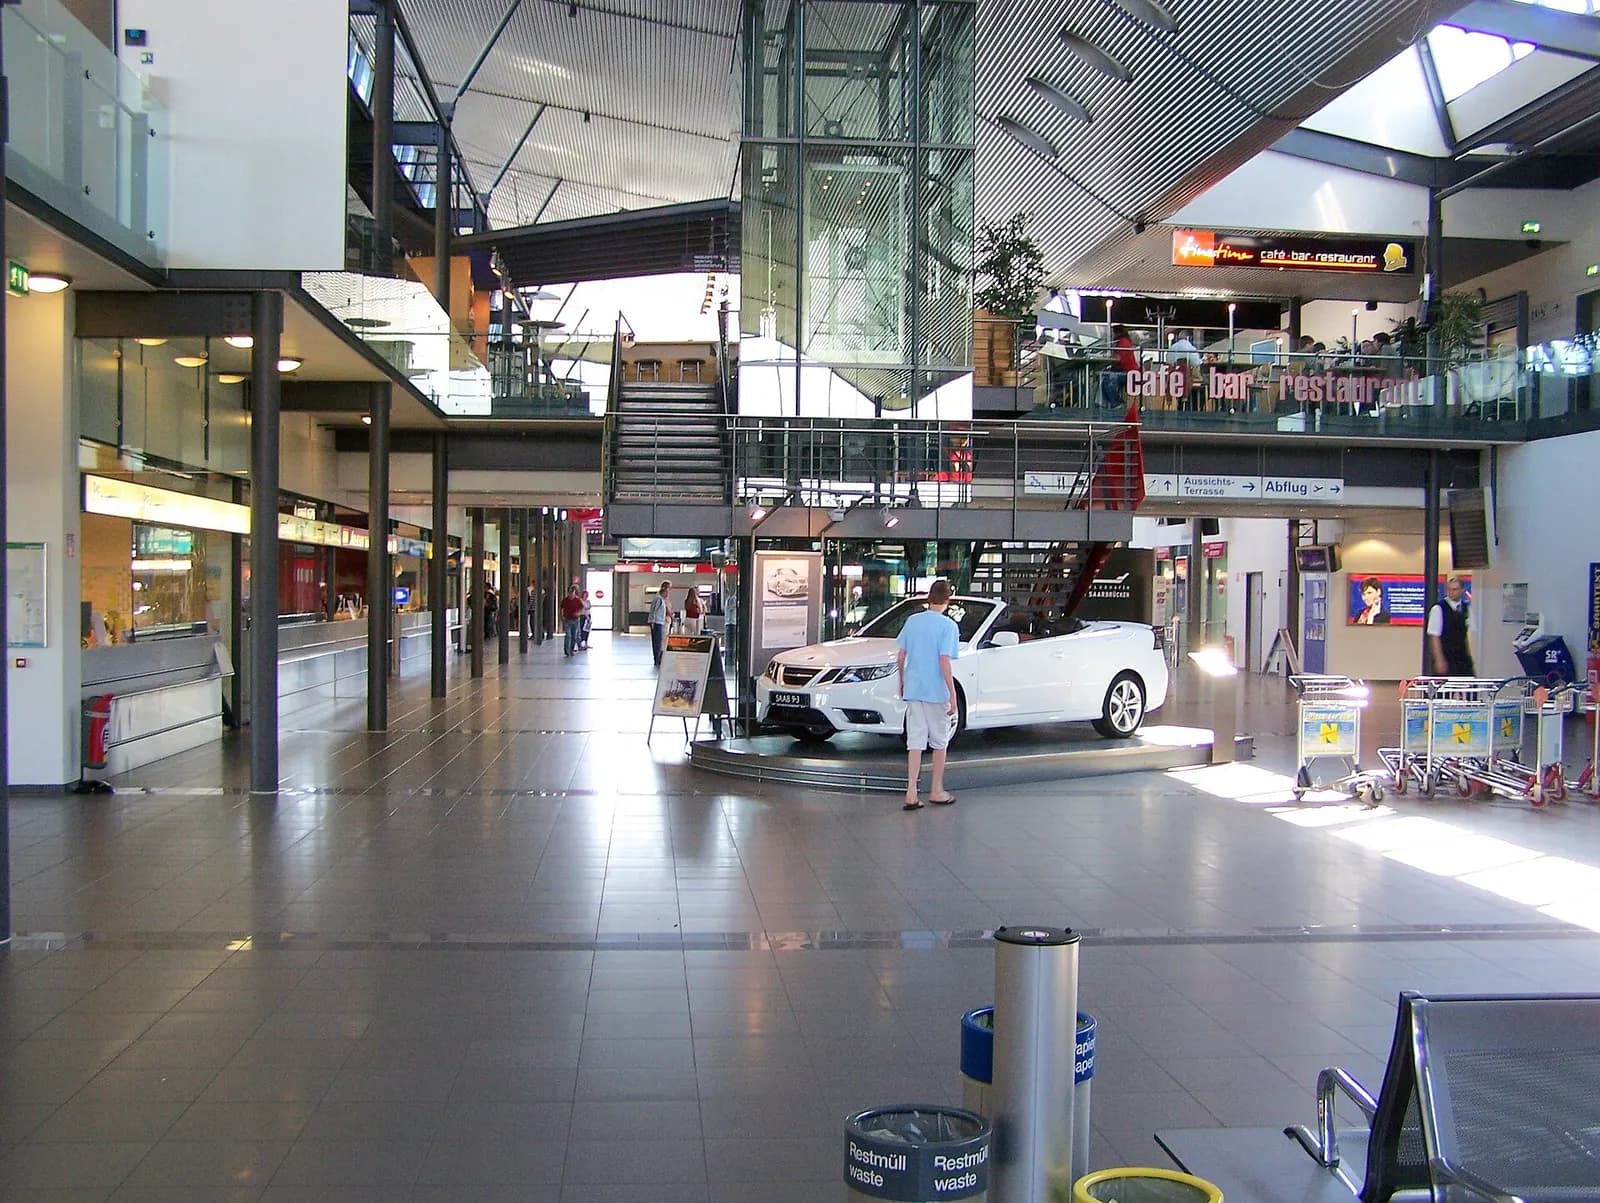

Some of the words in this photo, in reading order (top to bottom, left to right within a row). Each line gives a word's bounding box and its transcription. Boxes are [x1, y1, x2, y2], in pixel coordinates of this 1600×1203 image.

[1260, 249, 1285, 260] café
[1291, 251, 1311, 261] bar
[1315, 253, 1376, 264] restaurant
[1126, 365, 1185, 398] café
[1208, 366, 1253, 400] bar
[1279, 371, 1424, 405] restaurant
[1184, 477, 1235, 487] Aussichts-
[1184, 487, 1225, 496] Terrasse
[1265, 481, 1308, 495] Abflug
[1074, 1056, 1094, 1075] aper
[849, 1141, 907, 1171] Restmüll
[849, 1165, 884, 1187] waste
[934, 1172, 977, 1192] waste
